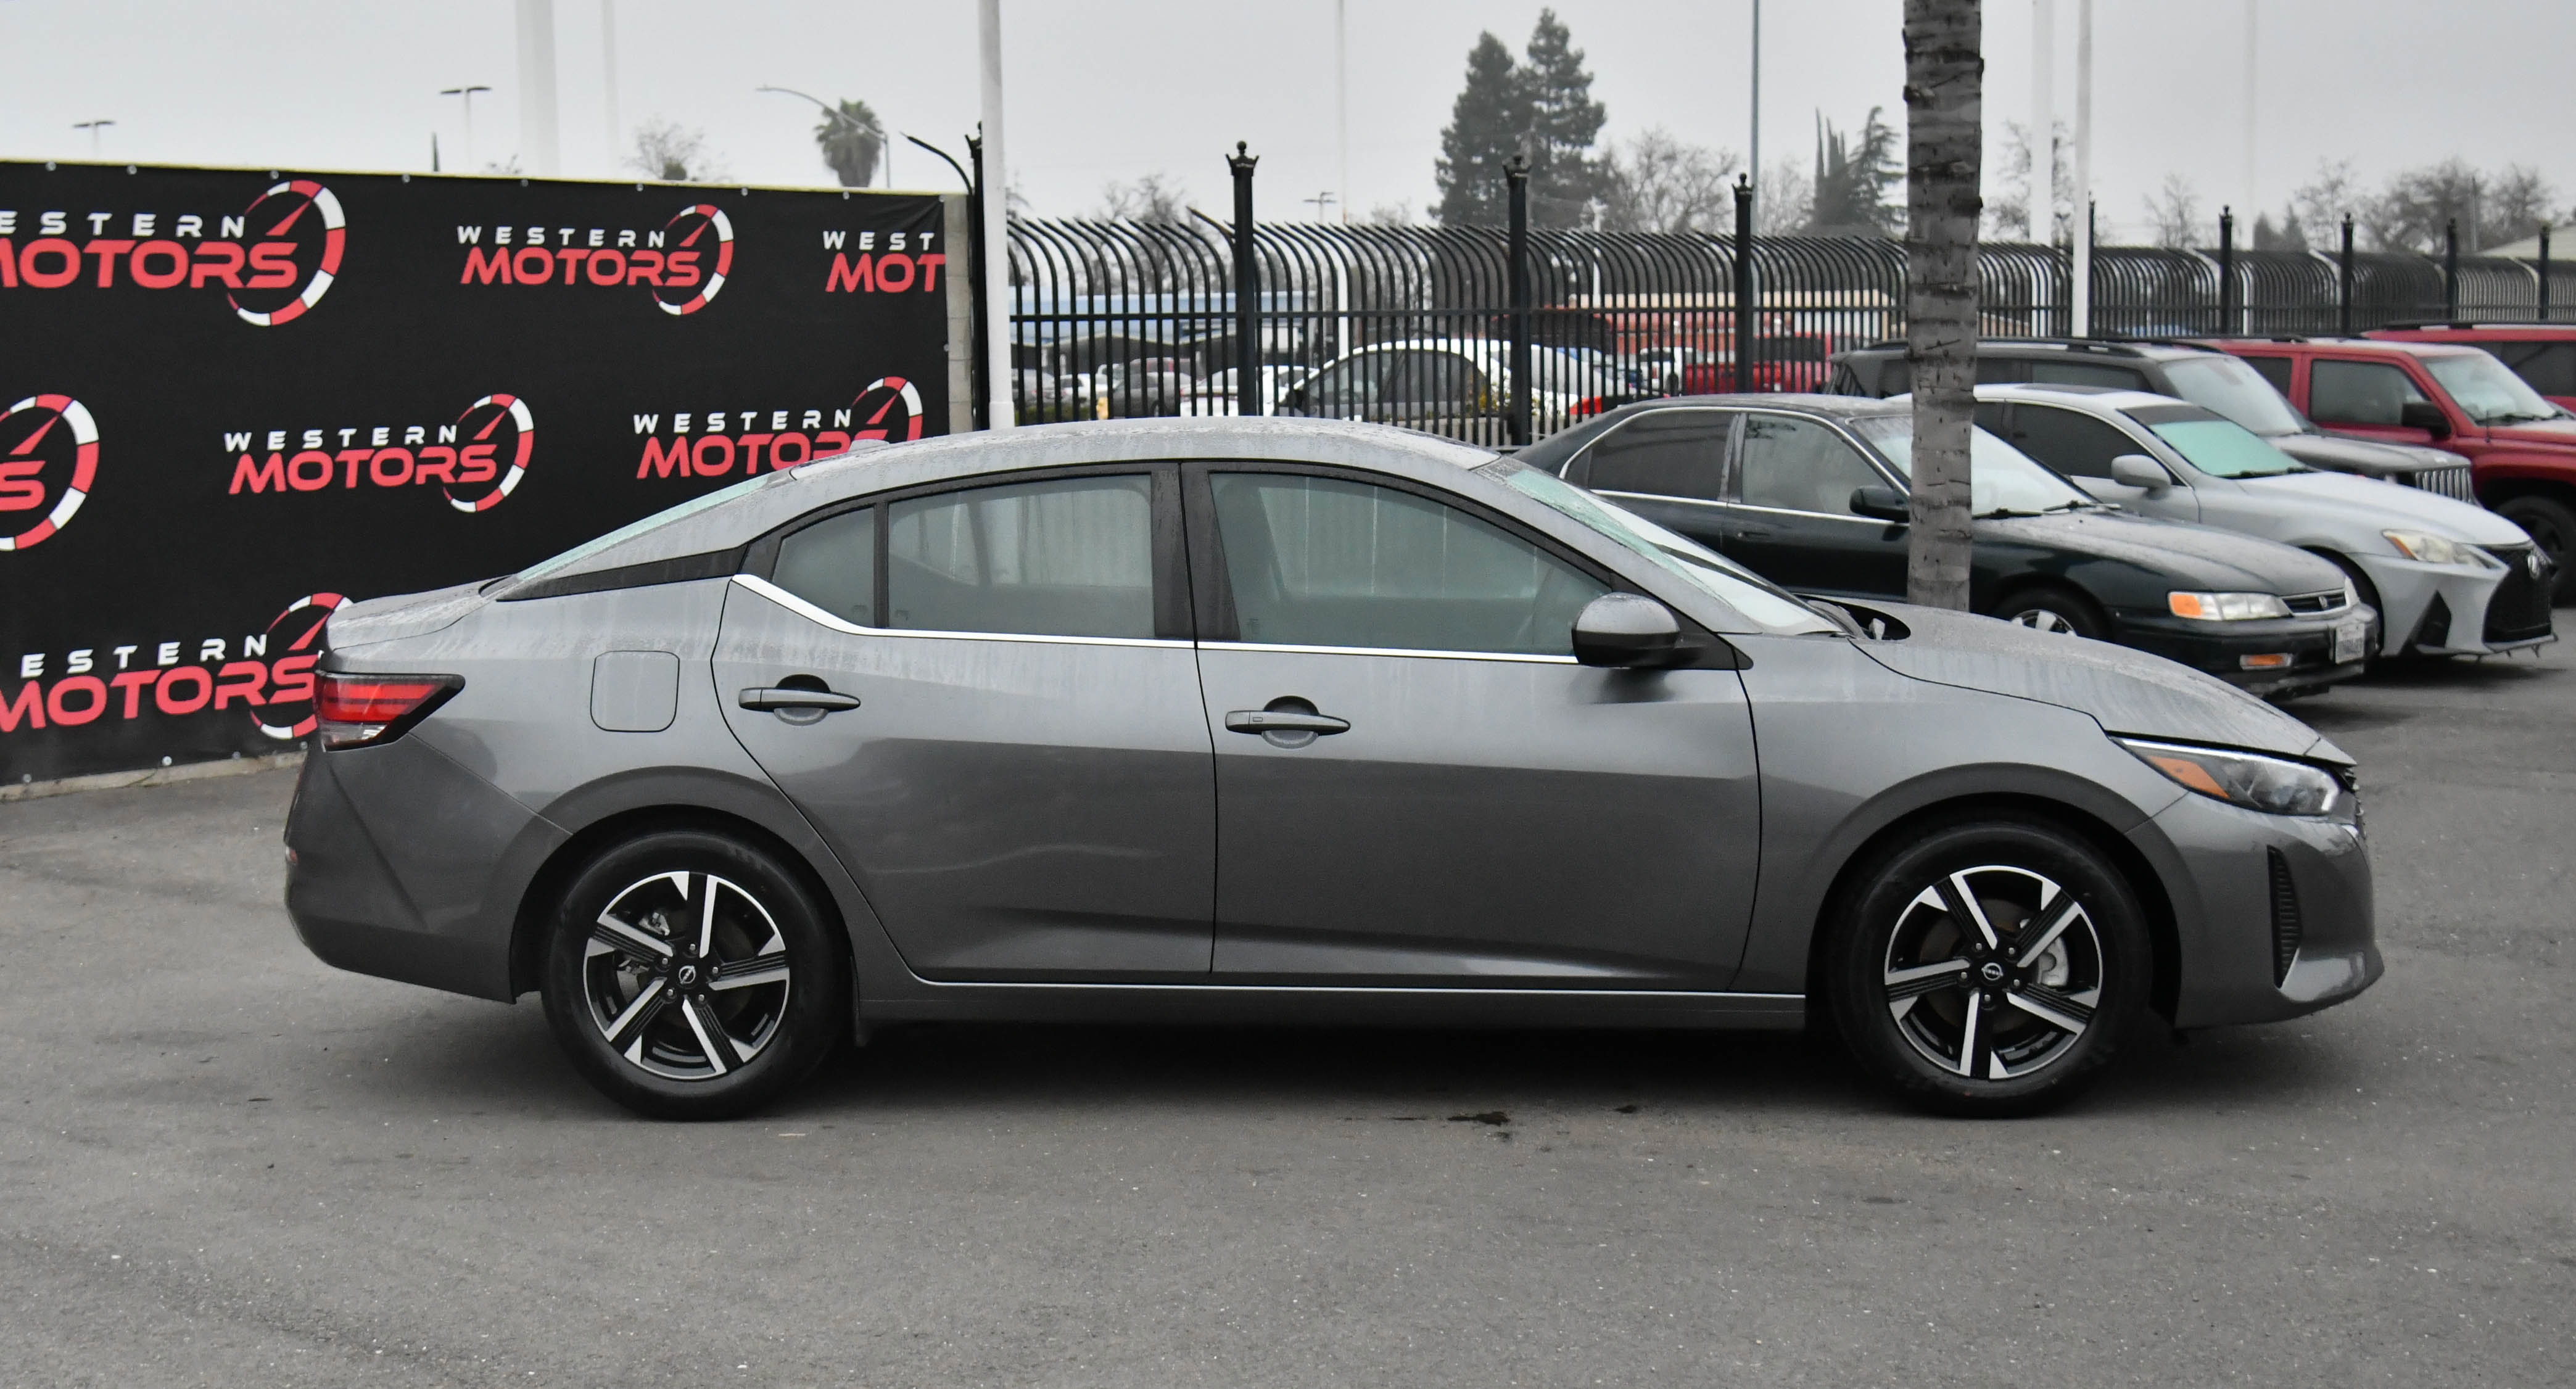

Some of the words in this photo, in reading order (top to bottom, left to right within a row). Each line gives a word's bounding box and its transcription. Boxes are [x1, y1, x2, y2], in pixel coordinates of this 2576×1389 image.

[457, 226, 665, 248] WESTERN
[823, 231, 935, 251] WEST
[0, 237, 298, 289] OTORS
[461, 246, 701, 287] MOTORS
[826, 252, 946, 293] MOT
[224, 424, 457, 452] WESTERN
[633, 408, 851, 434] WESTERN
[229, 443, 497, 495] MOTORS
[637, 429, 888, 479] MOTOR
[20, 633, 267, 678] ESTERN
